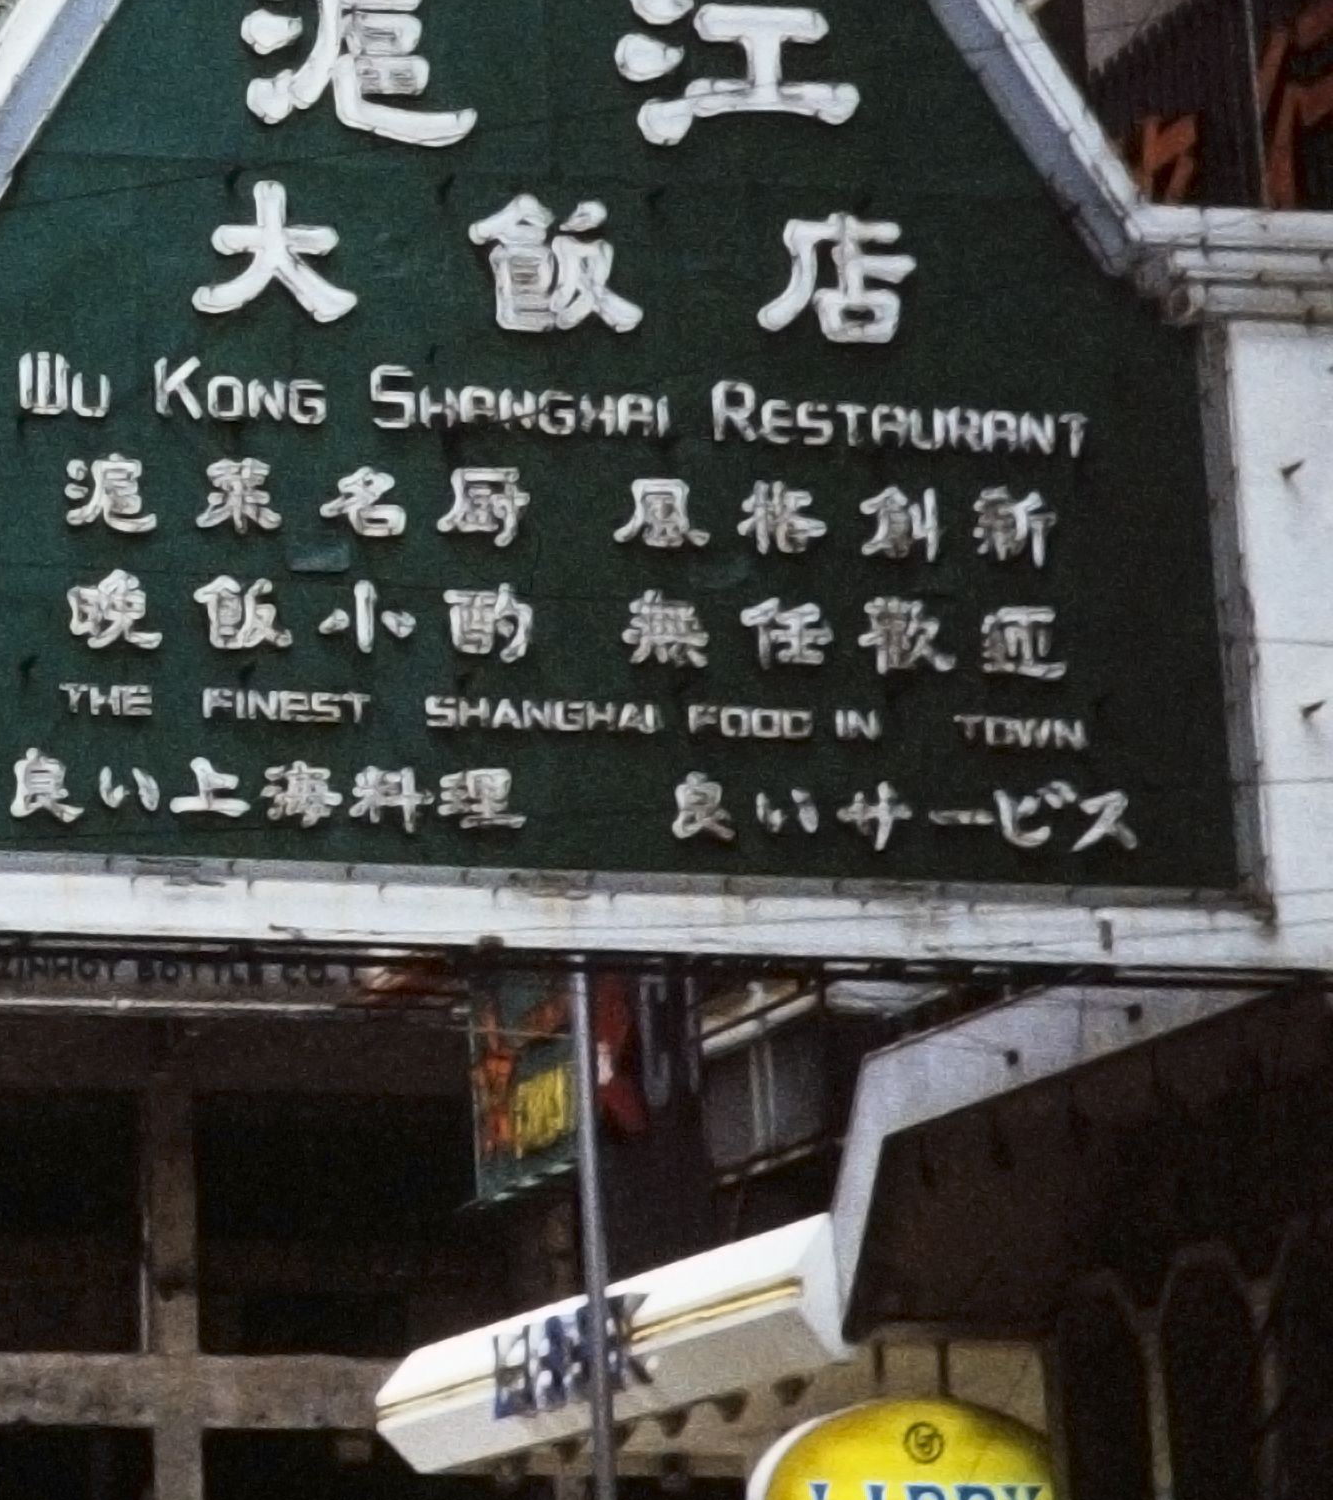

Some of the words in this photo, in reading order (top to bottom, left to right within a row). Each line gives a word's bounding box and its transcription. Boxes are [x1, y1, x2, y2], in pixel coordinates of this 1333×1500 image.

[192, 181, 916, 343] 大飯店
[59, 682, 153, 717] THE
[201, 687, 371, 724] FINEST
[424, 694, 661, 734] SHANGHAI
[687, 704, 814, 739] FOOD
[835, 708, 882, 740] IN
[953, 714, 1088, 750] TOWN
[9, 746, 527, 834] 良い上海料理
[671, 770, 1138, 852] 良いサービス
